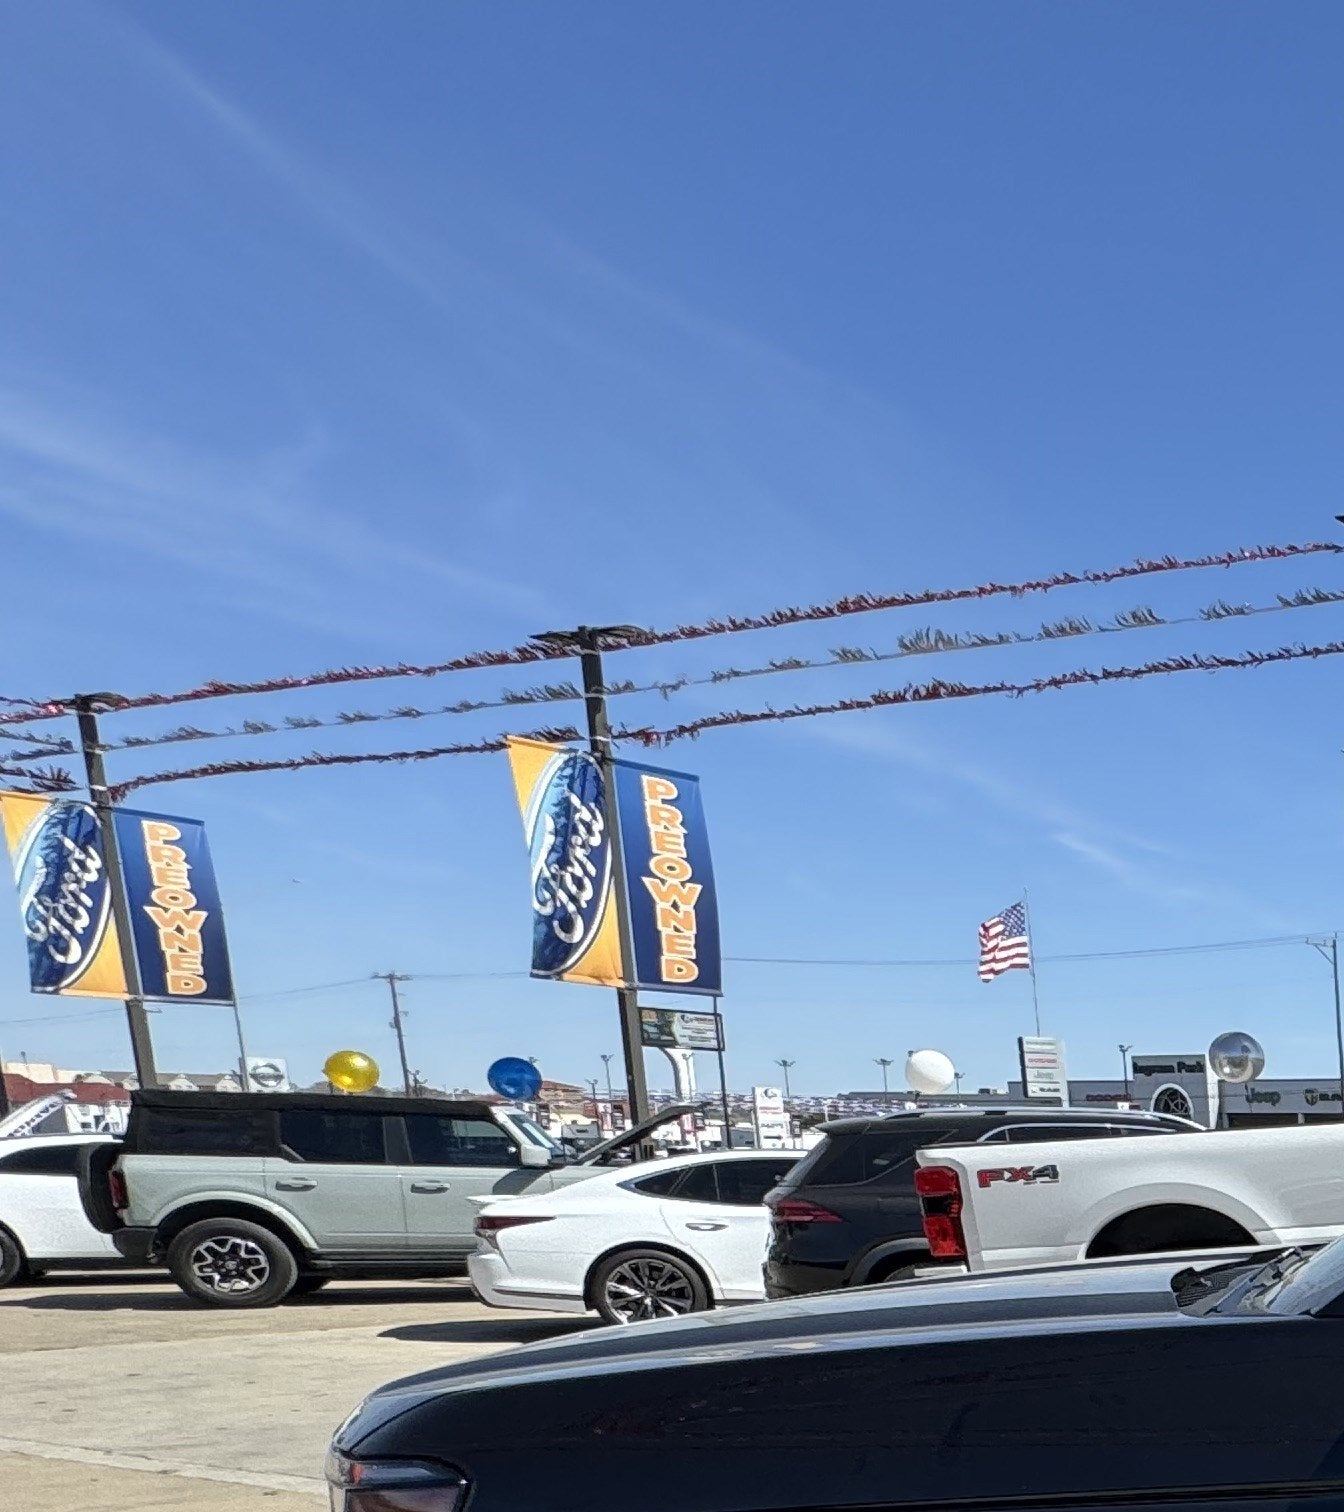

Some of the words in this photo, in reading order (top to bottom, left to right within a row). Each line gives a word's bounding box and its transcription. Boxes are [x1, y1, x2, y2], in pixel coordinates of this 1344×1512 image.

[20, 834, 103, 965] Ford
[140, 820, 208, 995] PREOWNED
[532, 790, 604, 943] Ford
[641, 775, 703, 983] PREOWNED
[977, 1165, 1059, 1188] FX4
